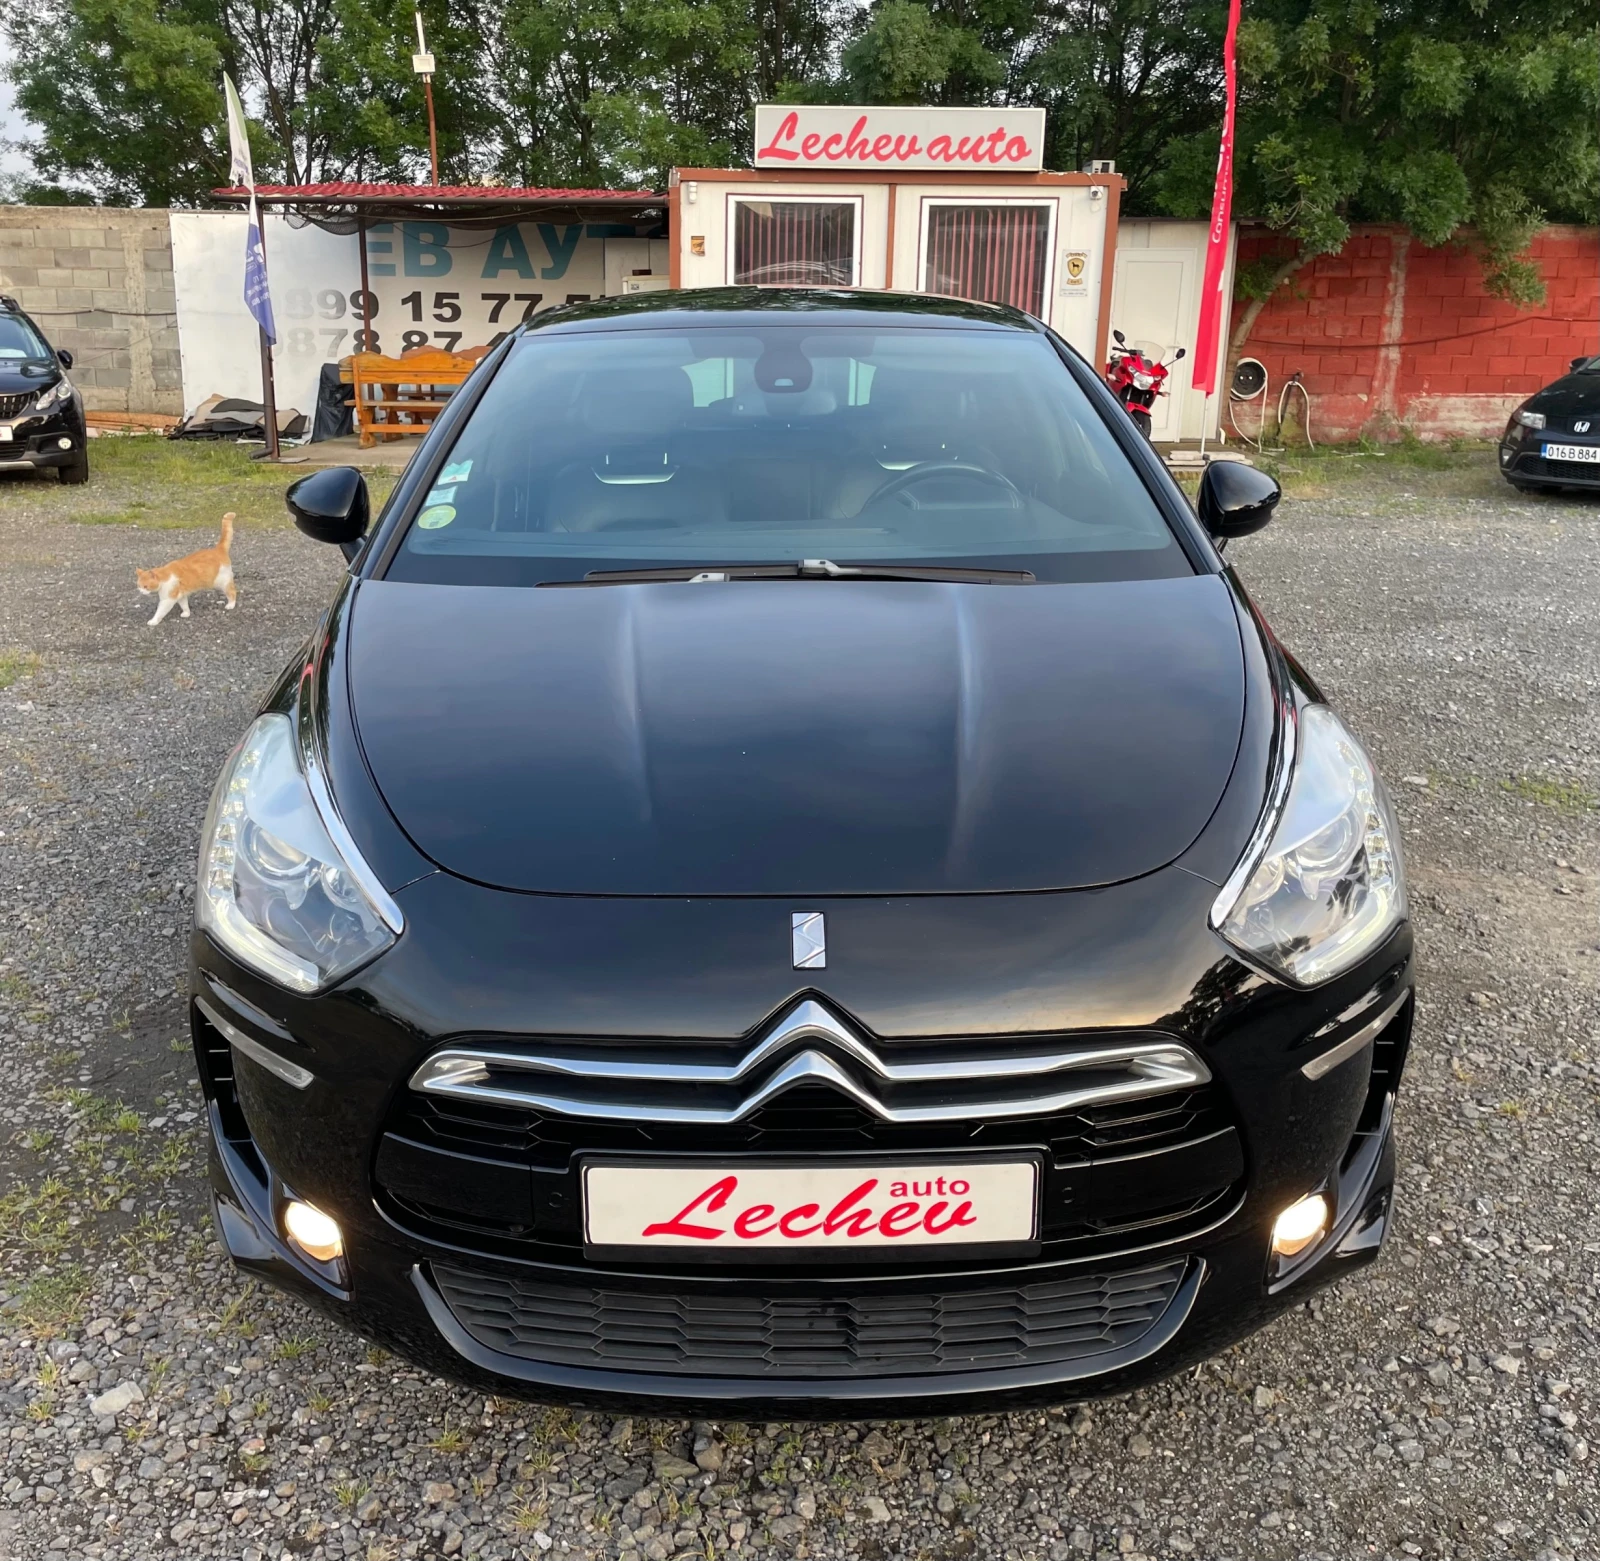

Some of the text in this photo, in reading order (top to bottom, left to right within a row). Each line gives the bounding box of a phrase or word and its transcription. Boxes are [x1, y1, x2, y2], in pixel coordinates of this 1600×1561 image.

[758, 111, 1032, 163] Lechev auto
[481, 223, 668, 280] АУТ
[401, 291, 462, 323] 15
[481, 294, 543, 324] 77
[402, 330, 463, 353] 87
[642, 1176, 977, 1240] Lechev
[890, 1176, 970, 1198] auto
